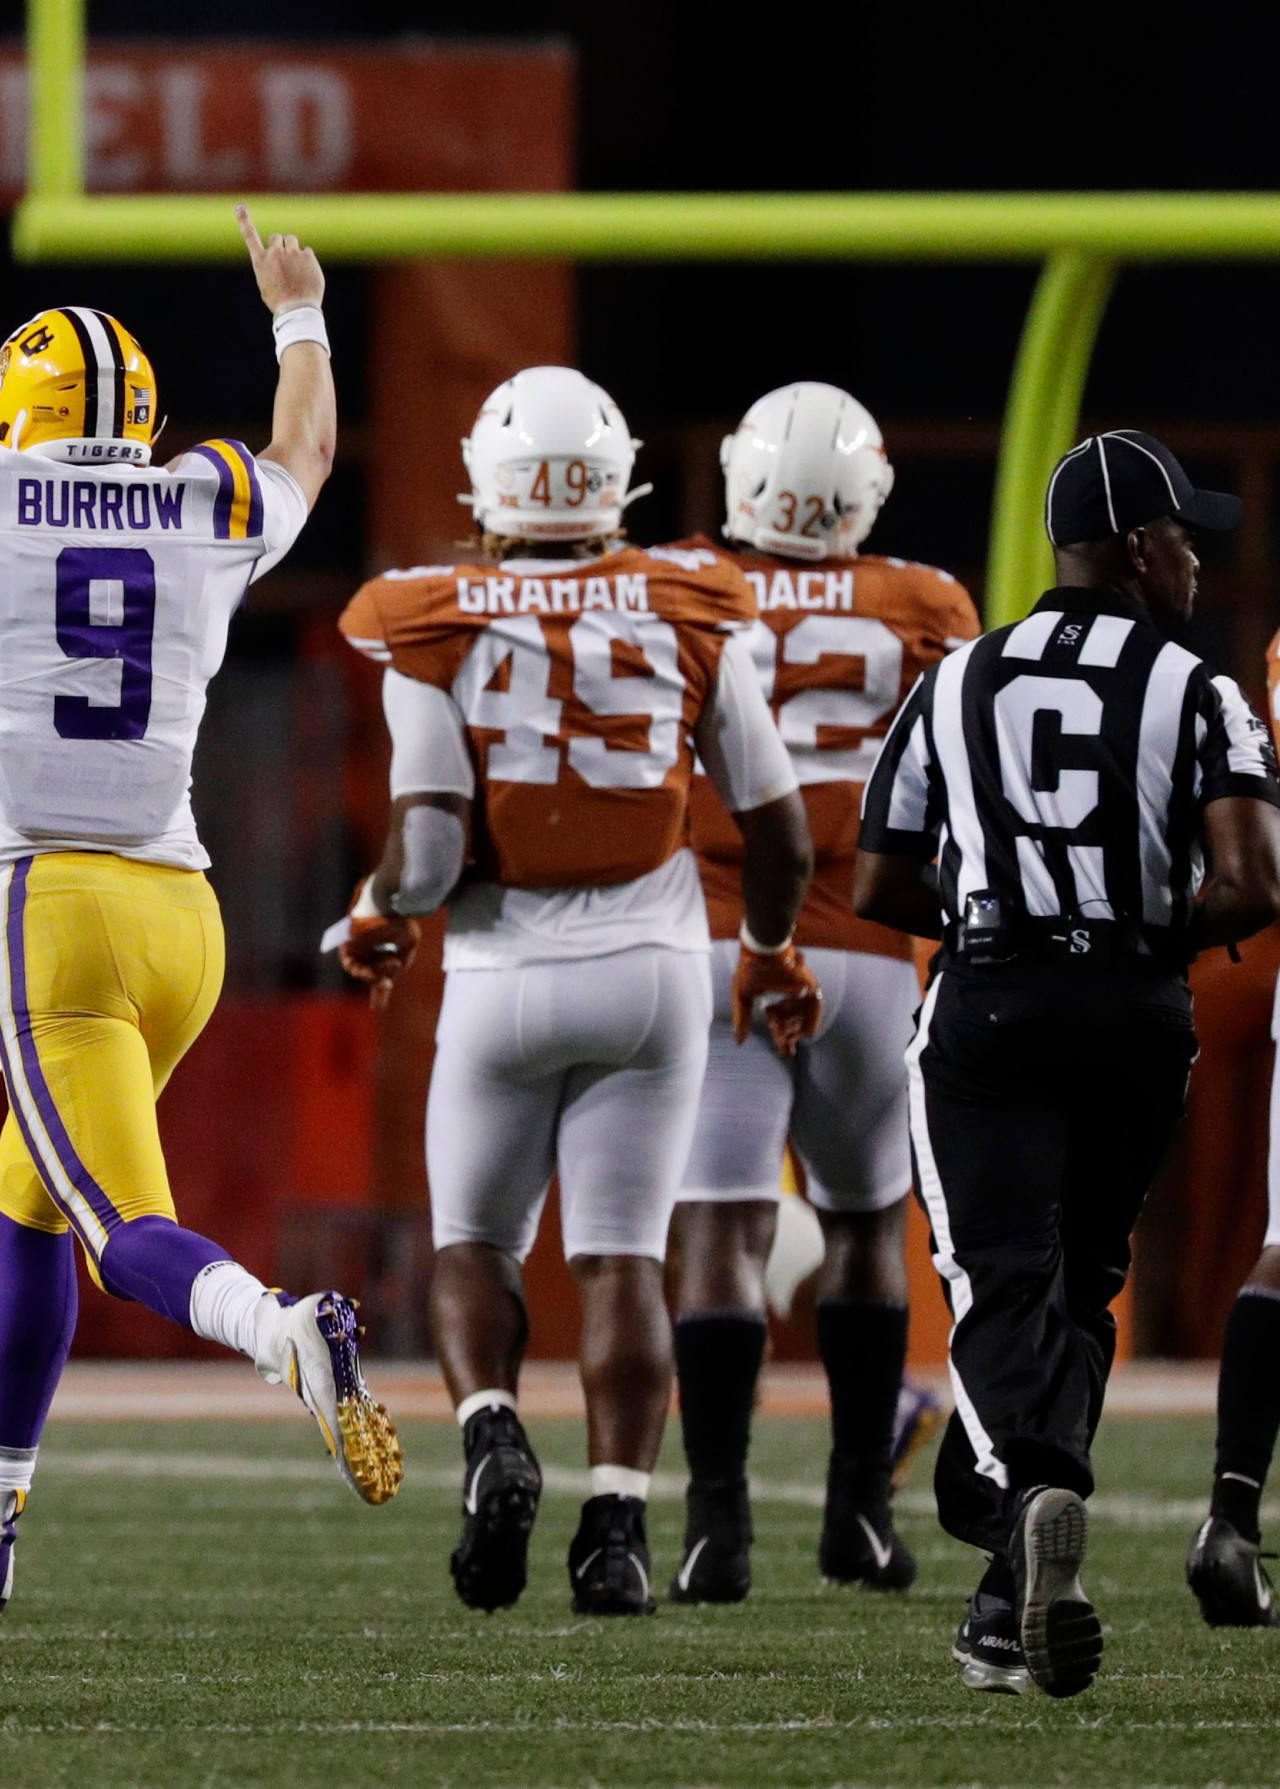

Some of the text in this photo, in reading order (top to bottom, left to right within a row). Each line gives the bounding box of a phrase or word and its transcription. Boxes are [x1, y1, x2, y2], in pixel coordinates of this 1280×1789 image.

[66, 445, 143, 459] TIGERS
[18, 478, 186, 530] BURROW
[529, 459, 587, 508] 49
[772, 489, 826, 539] 32
[457, 573, 650, 613] GRAHAM
[53, 547, 156, 740] 9
[452, 610, 686, 788] 49
[994, 674, 1104, 829] C
